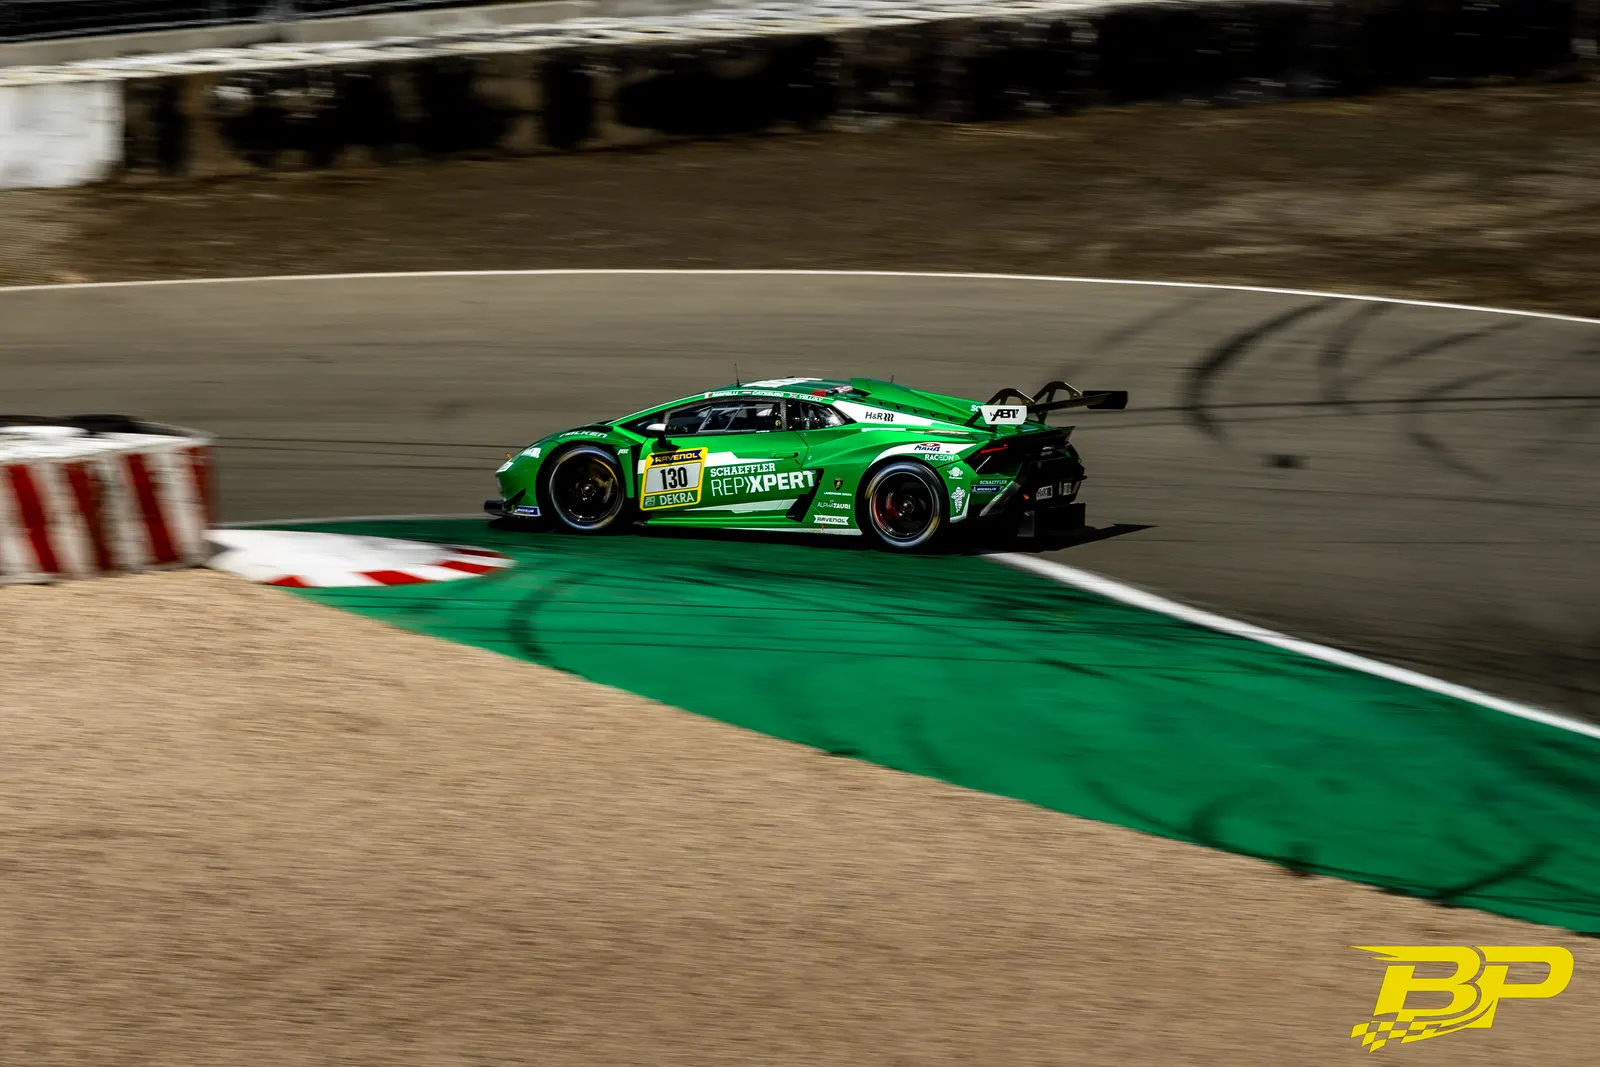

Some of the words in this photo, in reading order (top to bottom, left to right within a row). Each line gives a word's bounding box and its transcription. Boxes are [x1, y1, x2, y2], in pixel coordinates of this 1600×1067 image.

[865, 411, 883, 420] H&R
[990, 408, 1019, 422] ABT
[655, 452, 698, 463] RAVENOL
[710, 462, 776, 477] SCHAEFFLER
[660, 466, 688, 490] 130
[659, 491, 695, 506] DEKRA
